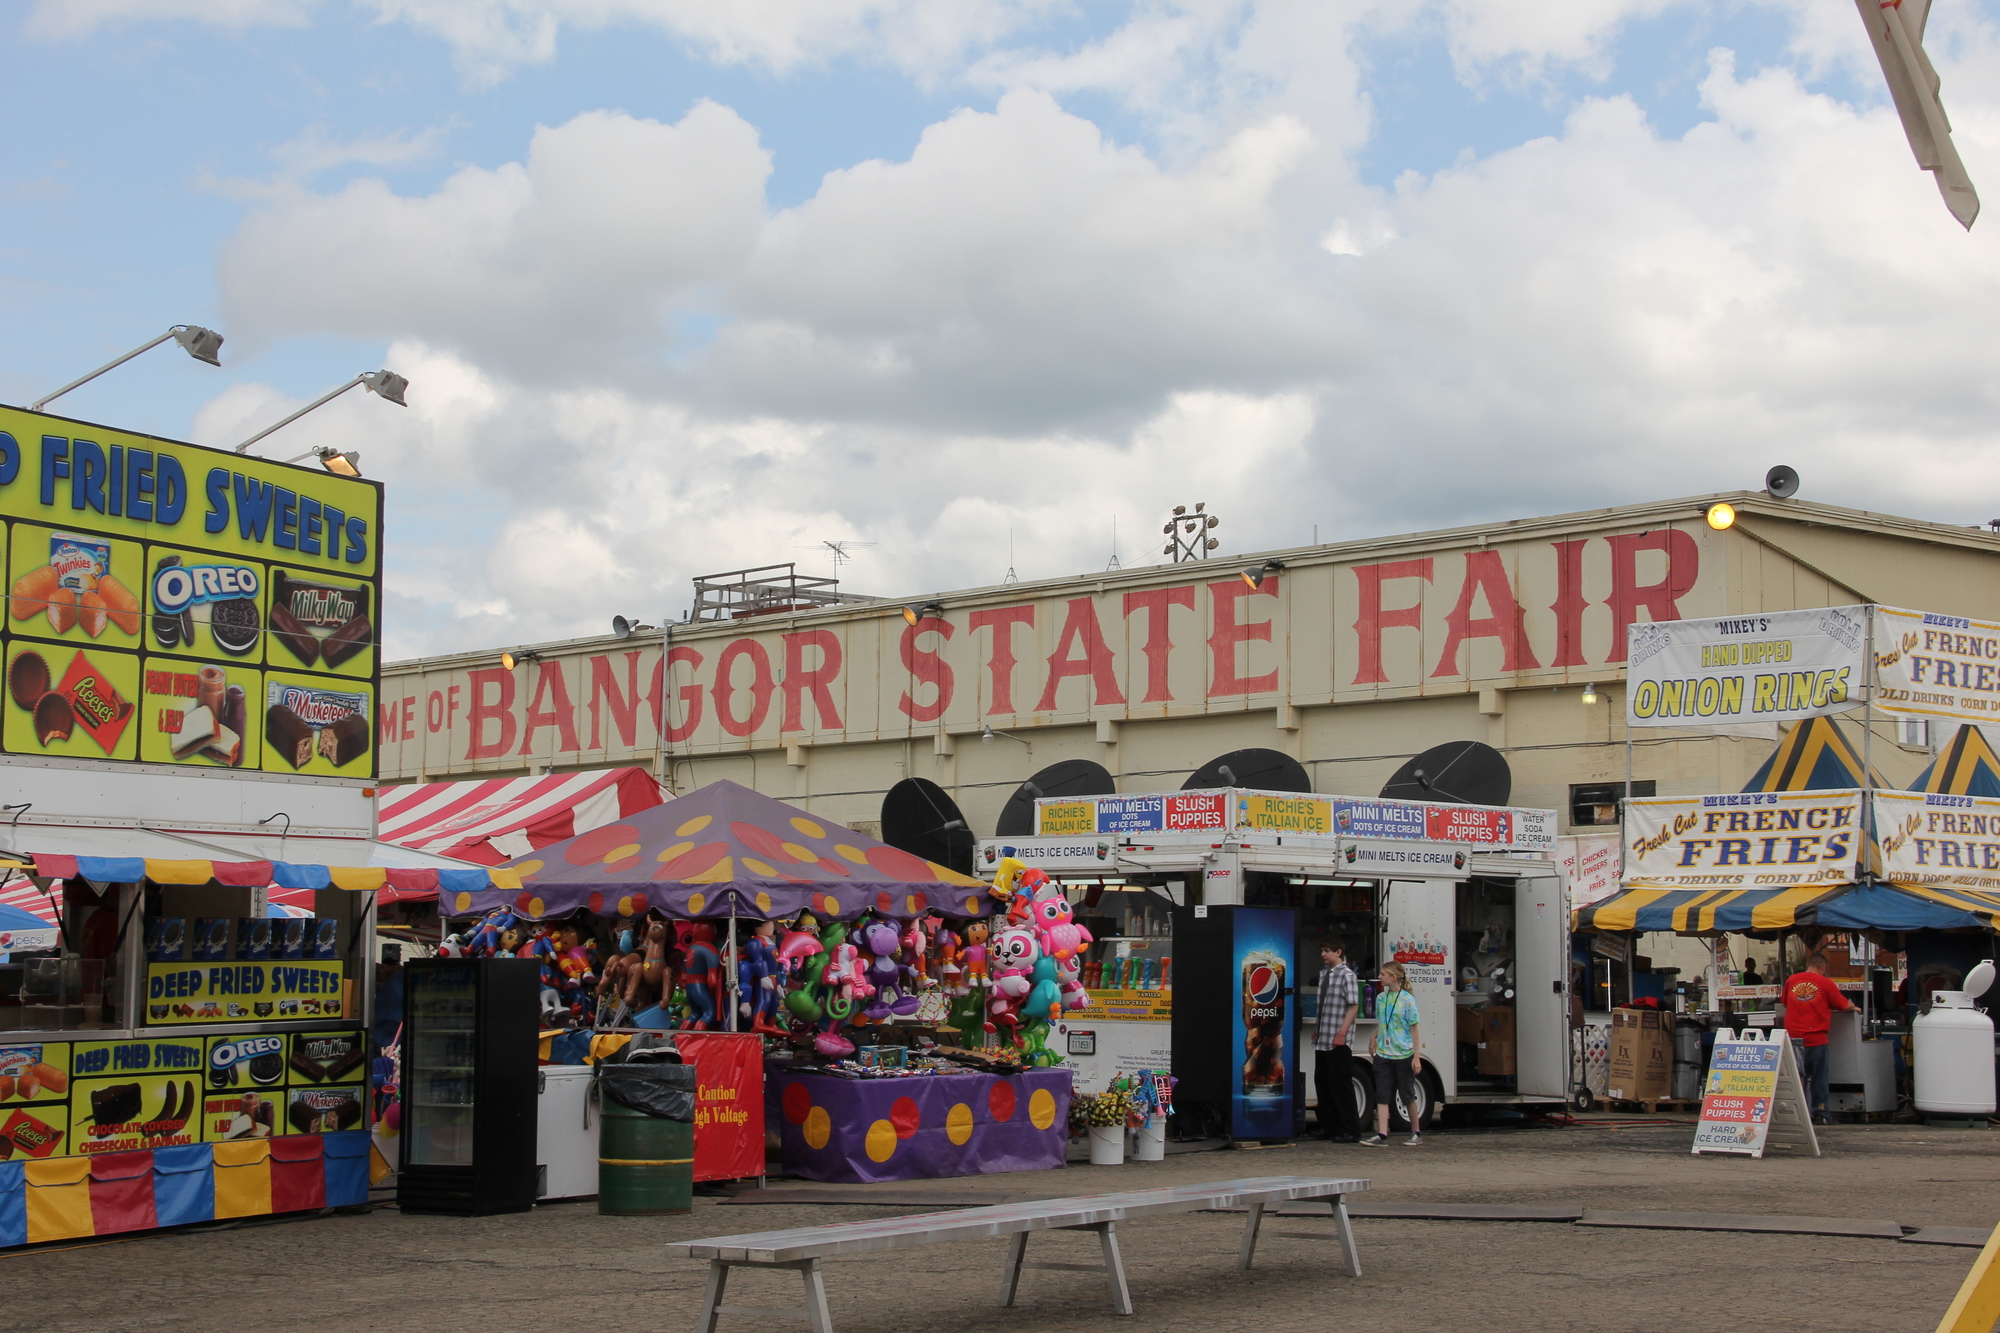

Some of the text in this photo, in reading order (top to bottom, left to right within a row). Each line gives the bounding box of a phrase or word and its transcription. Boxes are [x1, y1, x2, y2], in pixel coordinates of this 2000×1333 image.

[40, 434, 187, 526] FRIED
[205, 467, 367, 564] SWEETS
[54, 557, 91, 578] Twinkies
[157, 568, 257, 606] OREO
[1831, 610, 1861, 636] COLD
[1819, 618, 1860, 653] DRINKS
[1902, 631, 1919, 655] Cut
[428, 685, 460, 733] OF
[464, 630, 844, 761] BANGOR
[898, 575, 1280, 723] STATE
[1351, 528, 1700, 684] FAIR
[1631, 634, 1672, 667] DRINKS
[1923, 630, 2000, 660] FRENC
[1702, 640, 1792, 667] HAND DIPPED
[73, 676, 114, 723] Reese's
[1634, 666, 1851, 719] ONION RINGS
[1879, 688, 1909, 701] OLD
[1912, 692, 1954, 706] DRINKS
[1962, 698, 1988, 711] CORN
[1100, 800, 1161, 814] MINI MELTS
[1176, 798, 1215, 811] SLUSH
[1265, 800, 1314, 815] RICHIE'S
[1704, 794, 1778, 807] MIKEY'S
[1048, 806, 1085, 819] RICHIE'S
[1170, 812, 1221, 826] PUPPIES
[1352, 806, 1422, 824] MINI MELTS
[1452, 811, 1487, 826] SLUSH
[1042, 820, 1092, 832] ITALIAN ICE
[1130, 820, 1151, 828] CREAM
[1256, 815, 1323, 830] ITALIAN ICE
[1354, 822, 1371, 832] DOTS
[1372, 824, 1382, 832] OF
[1398, 826, 1421, 834] CREAM
[1704, 805, 1857, 836] FRENCH
[1447, 826, 1493, 840] PUPPIES
[1528, 835, 1552, 843] CREAM
[1633, 810, 1698, 860] Fresh Cut
[1018, 848, 1045, 858] MELTS
[1046, 848, 1061, 857] ICE
[1062, 846, 1095, 857] CREAM
[1358, 850, 1452, 864] MINI MELTS ICE CREAM
[1582, 848, 1608, 866] CHICKEN
[1676, 832, 1853, 868] FRIES
[1590, 878, 1606, 891] FRIES
[1679, 875, 1745, 884] DRINKS
[1754, 874, 1801, 884] CORN
[1889, 872, 1919, 883] CORN
[16, 935, 44, 947] pepsi
[150, 966, 339, 999] DEEP FRIED SWEETS
[1250, 1007, 1278, 1020] pepsi
[213, 1037, 281, 1066] OREO
[1618, 1045, 1630, 1059] LX
[1729, 1054, 1760, 1062] MELTS
[1736, 1046, 1757, 1055] MINI
[76, 1044, 200, 1073] DEEP FRIED SWEETS
[1066, 1061, 1080, 1070] Tyler
[1732, 1076, 1766, 1084] RICHIE'S
[699, 1084, 736, 1102] Caution
[1724, 1084, 1754, 1092] ITALIAN
[1712, 1100, 1743, 1109] SLUSH
[694, 1106, 748, 1129] igh Voltage
[1706, 1109, 1746, 1119] PUPPIES
[14, 1122, 48, 1146] Reese's
[88, 1120, 187, 1136] CHOCOLATE COVERED
[1711, 1126, 1736, 1134] HARD
[79, 1134, 192, 1153] CHEESECAKE & BANANAS
[1696, 1135, 1748, 1144] ICE CREAM
